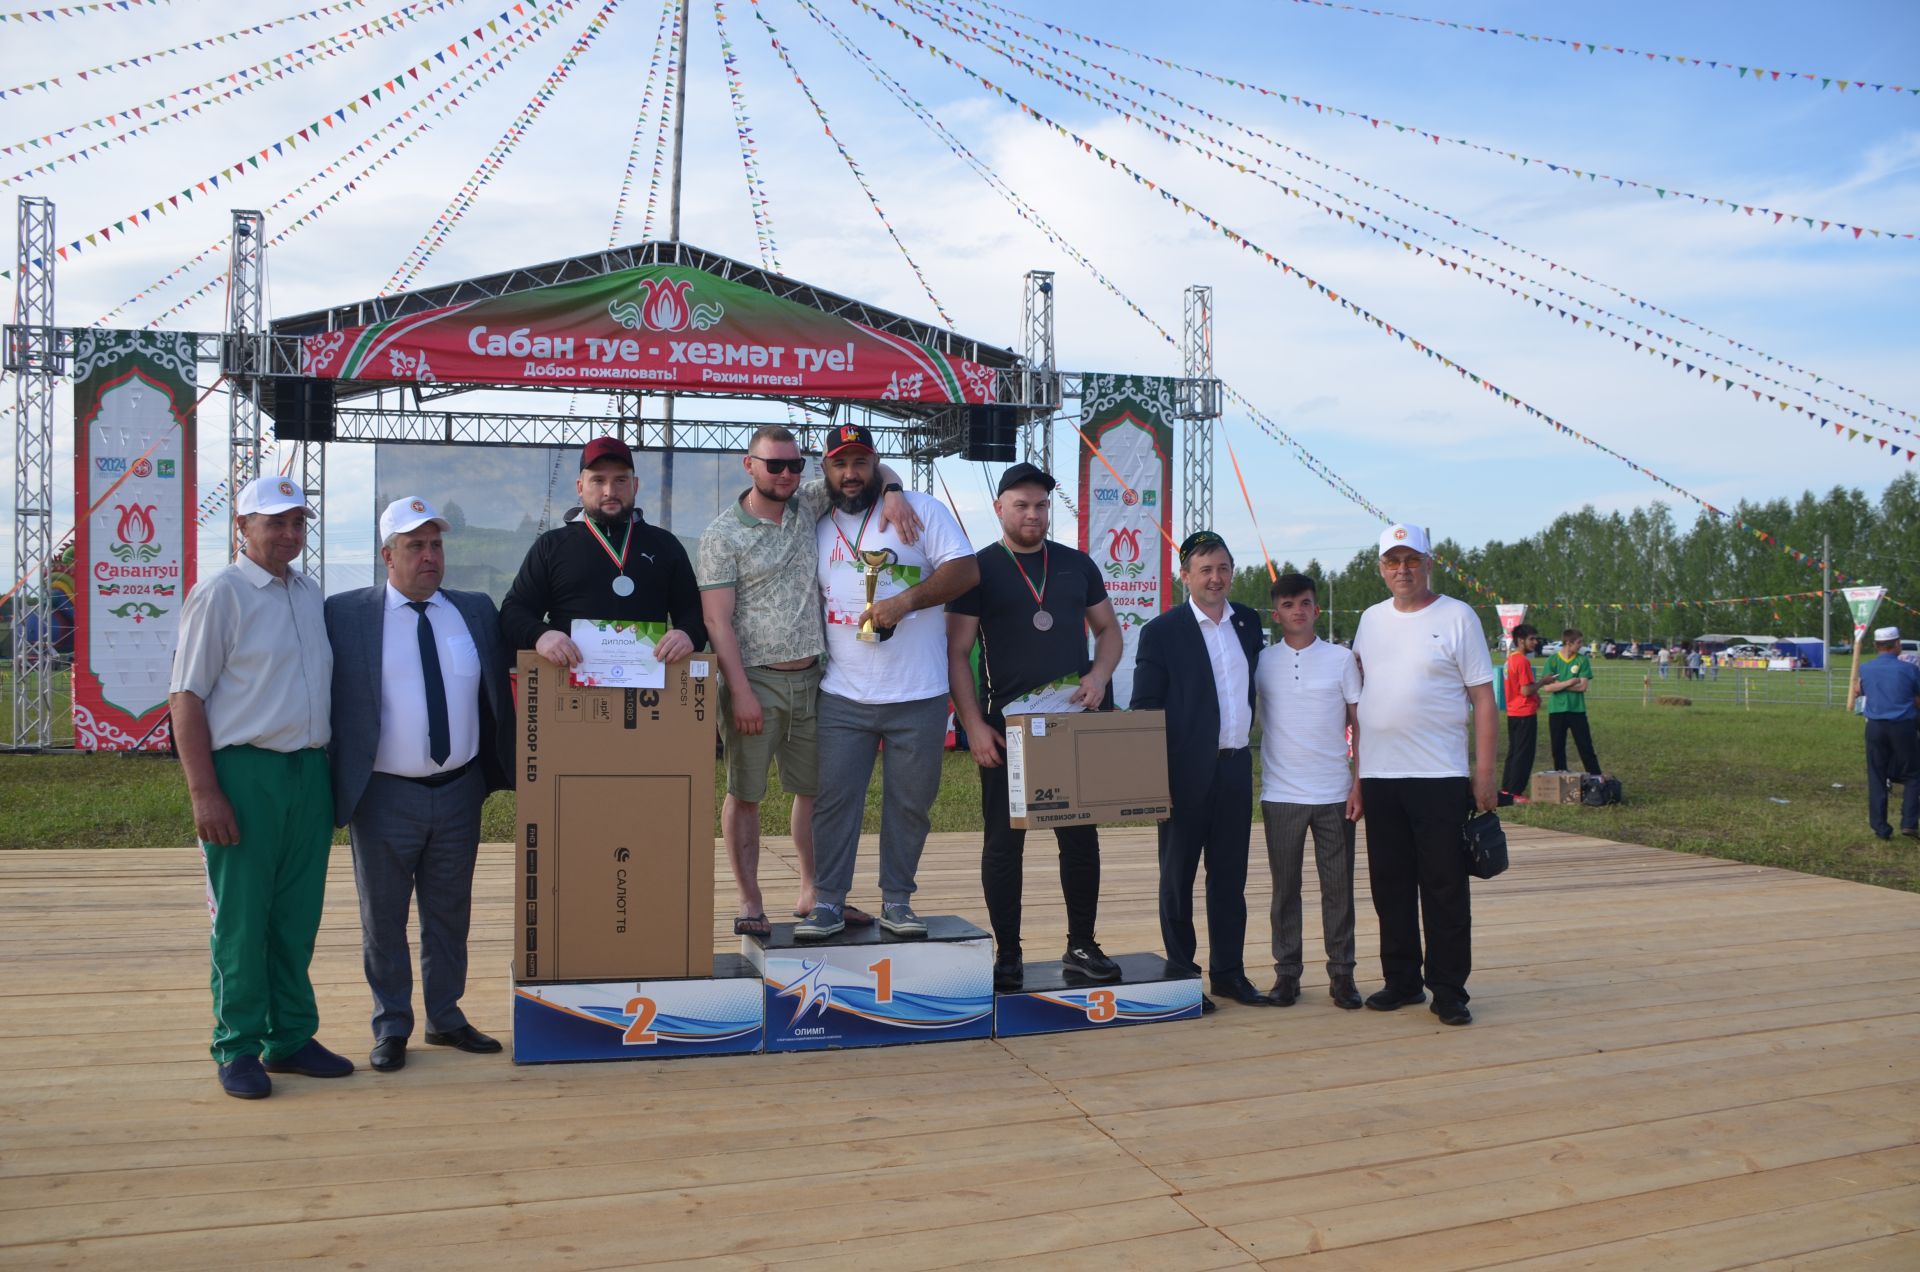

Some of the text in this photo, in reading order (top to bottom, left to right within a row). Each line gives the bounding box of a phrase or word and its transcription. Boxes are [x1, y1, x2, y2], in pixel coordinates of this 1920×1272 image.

[468, 325, 574, 359] Сабан
[584, 337, 639, 362] туе
[668, 341, 785, 368] хезмәт
[793, 342, 855, 372] туе!
[523, 361, 677, 381] Добро пожаловать!
[702, 368, 803, 386] Рәхим итегез!
[101, 457, 127, 472] 2024
[1099, 488, 1119, 501] 2024
[94, 560, 179, 581] Сабантуй
[122, 585, 150, 595] 2024
[1104, 576, 1157, 593] абантуй
[1113, 597, 1135, 606] 2024
[601, 638, 636, 646] ДИПЛОМ
[680, 669, 688, 706] 43FCS1
[527, 667, 538, 783] ТЕЛЕВИЗОР LED
[1035, 788, 1060, 801] 24"
[1036, 812, 1091, 823] ТЕЛЕВИЗОР LED
[616, 869, 627, 934] САЛЮТ ТВ
[868, 957, 893, 1003] 1
[1086, 990, 1117, 1022] 3
[623, 996, 658, 1045] 2
[794, 1027, 825, 1036] ОЛИМП
